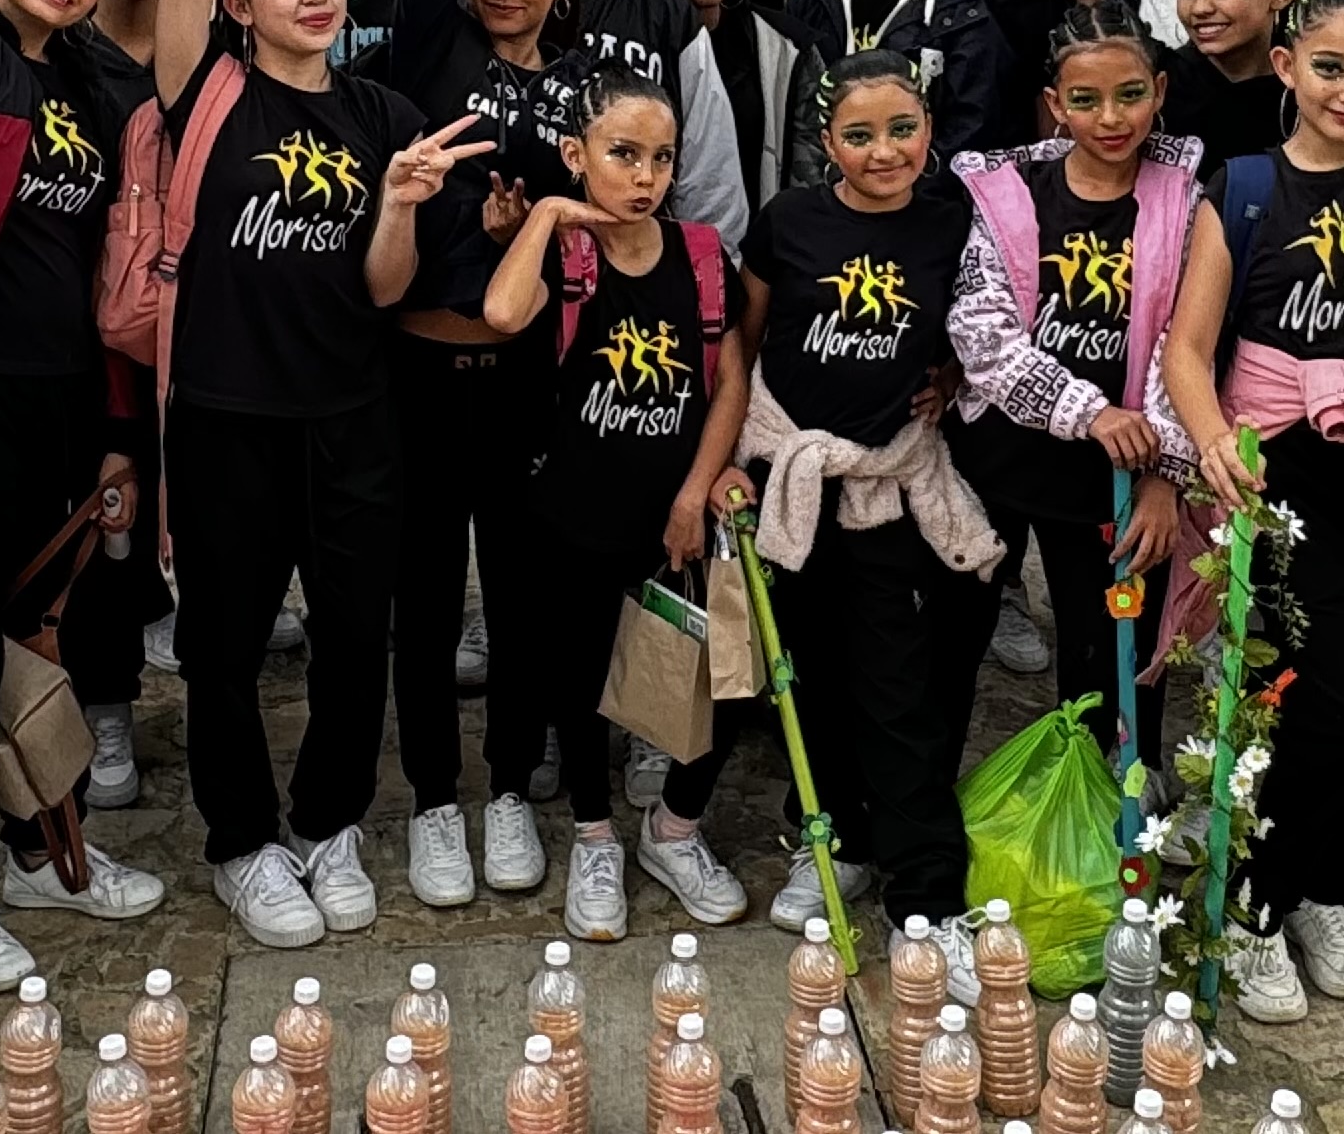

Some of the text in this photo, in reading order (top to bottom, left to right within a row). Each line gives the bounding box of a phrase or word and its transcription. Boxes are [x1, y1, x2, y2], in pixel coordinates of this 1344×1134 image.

[230, 190, 369, 260] Morisot
[802, 309, 912, 364] Morisot
[580, 376, 692, 438] Morisot
